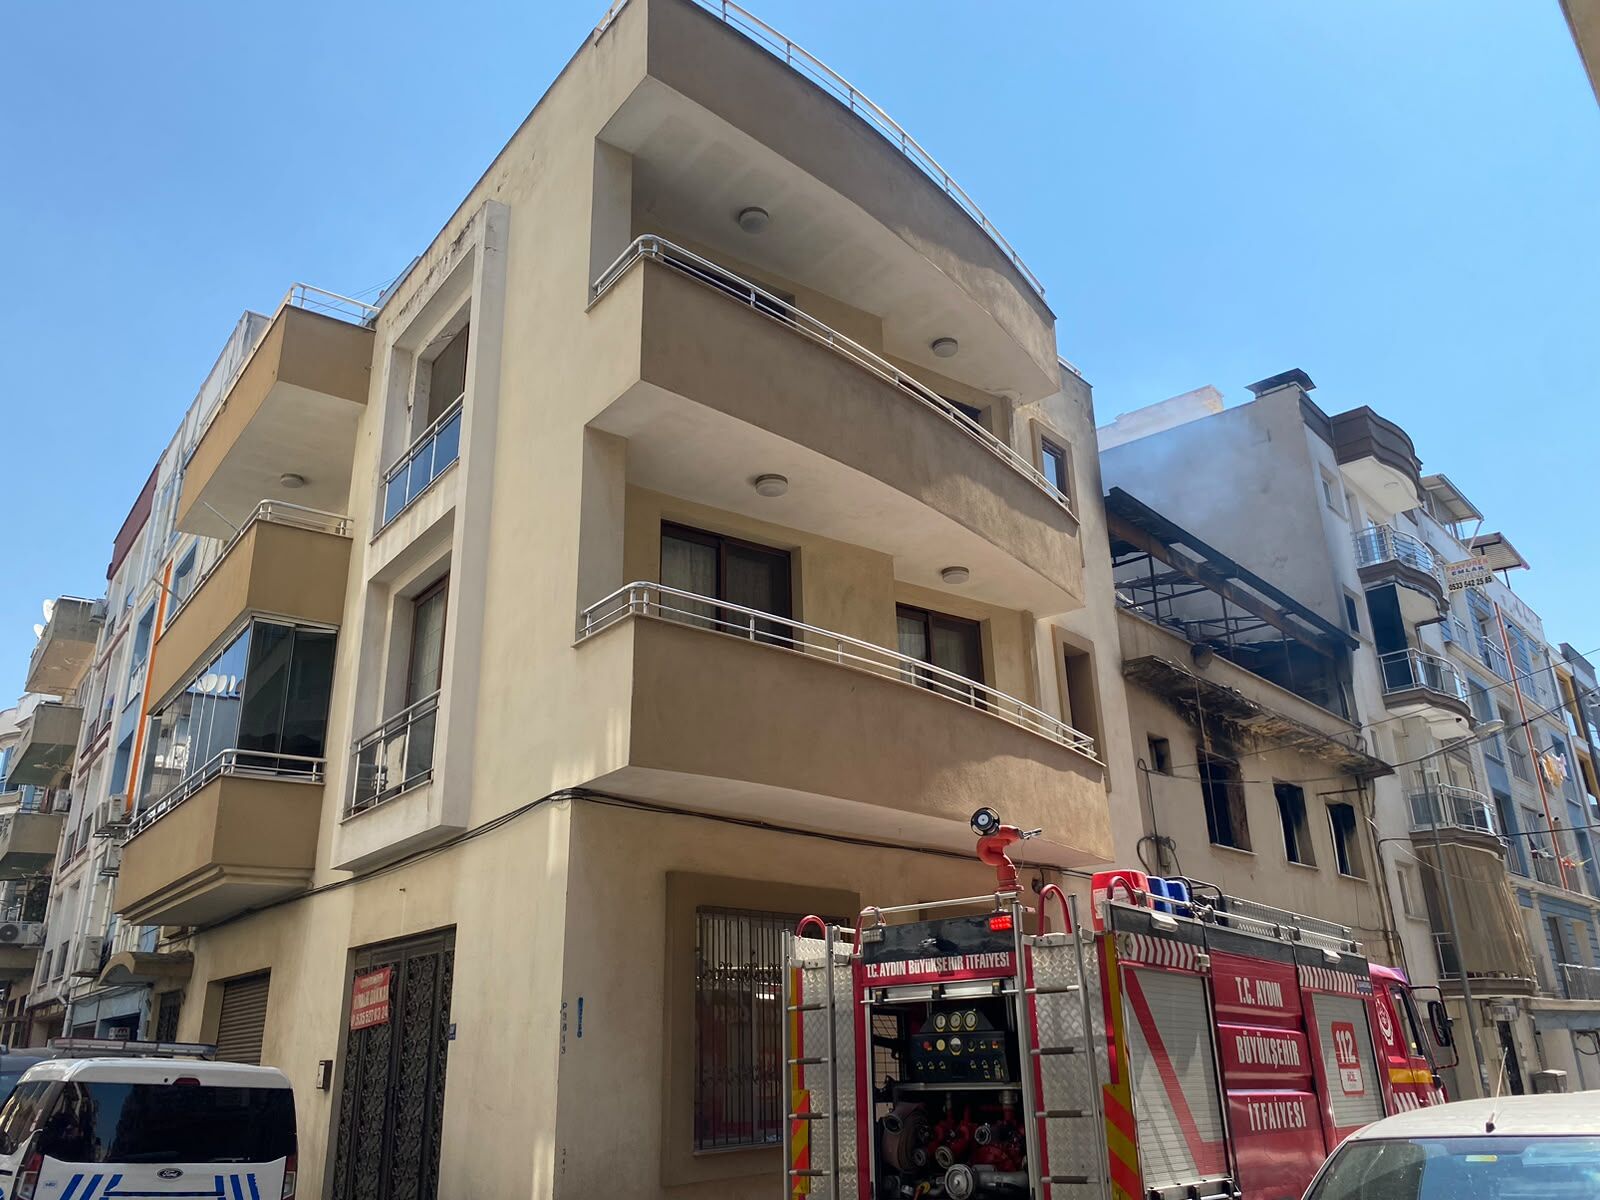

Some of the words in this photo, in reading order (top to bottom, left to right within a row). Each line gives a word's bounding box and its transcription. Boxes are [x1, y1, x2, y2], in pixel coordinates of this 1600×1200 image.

[1451, 565, 1484, 576] EMLAK
[879, 960, 906, 978] AYDIN
[908, 955, 964, 975] BÜYÜKŞEHİR
[965, 951, 1010, 970] İTFAİYESİ
[1234, 976, 1255, 1005] T.C.
[1255, 979, 1284, 1008] AYDIN
[1235, 1030, 1301, 1069] BÜYÜKŞEHİR
[1335, 1030, 1357, 1063] 112
[1247, 1096, 1306, 1131] İTFAİYESİ
